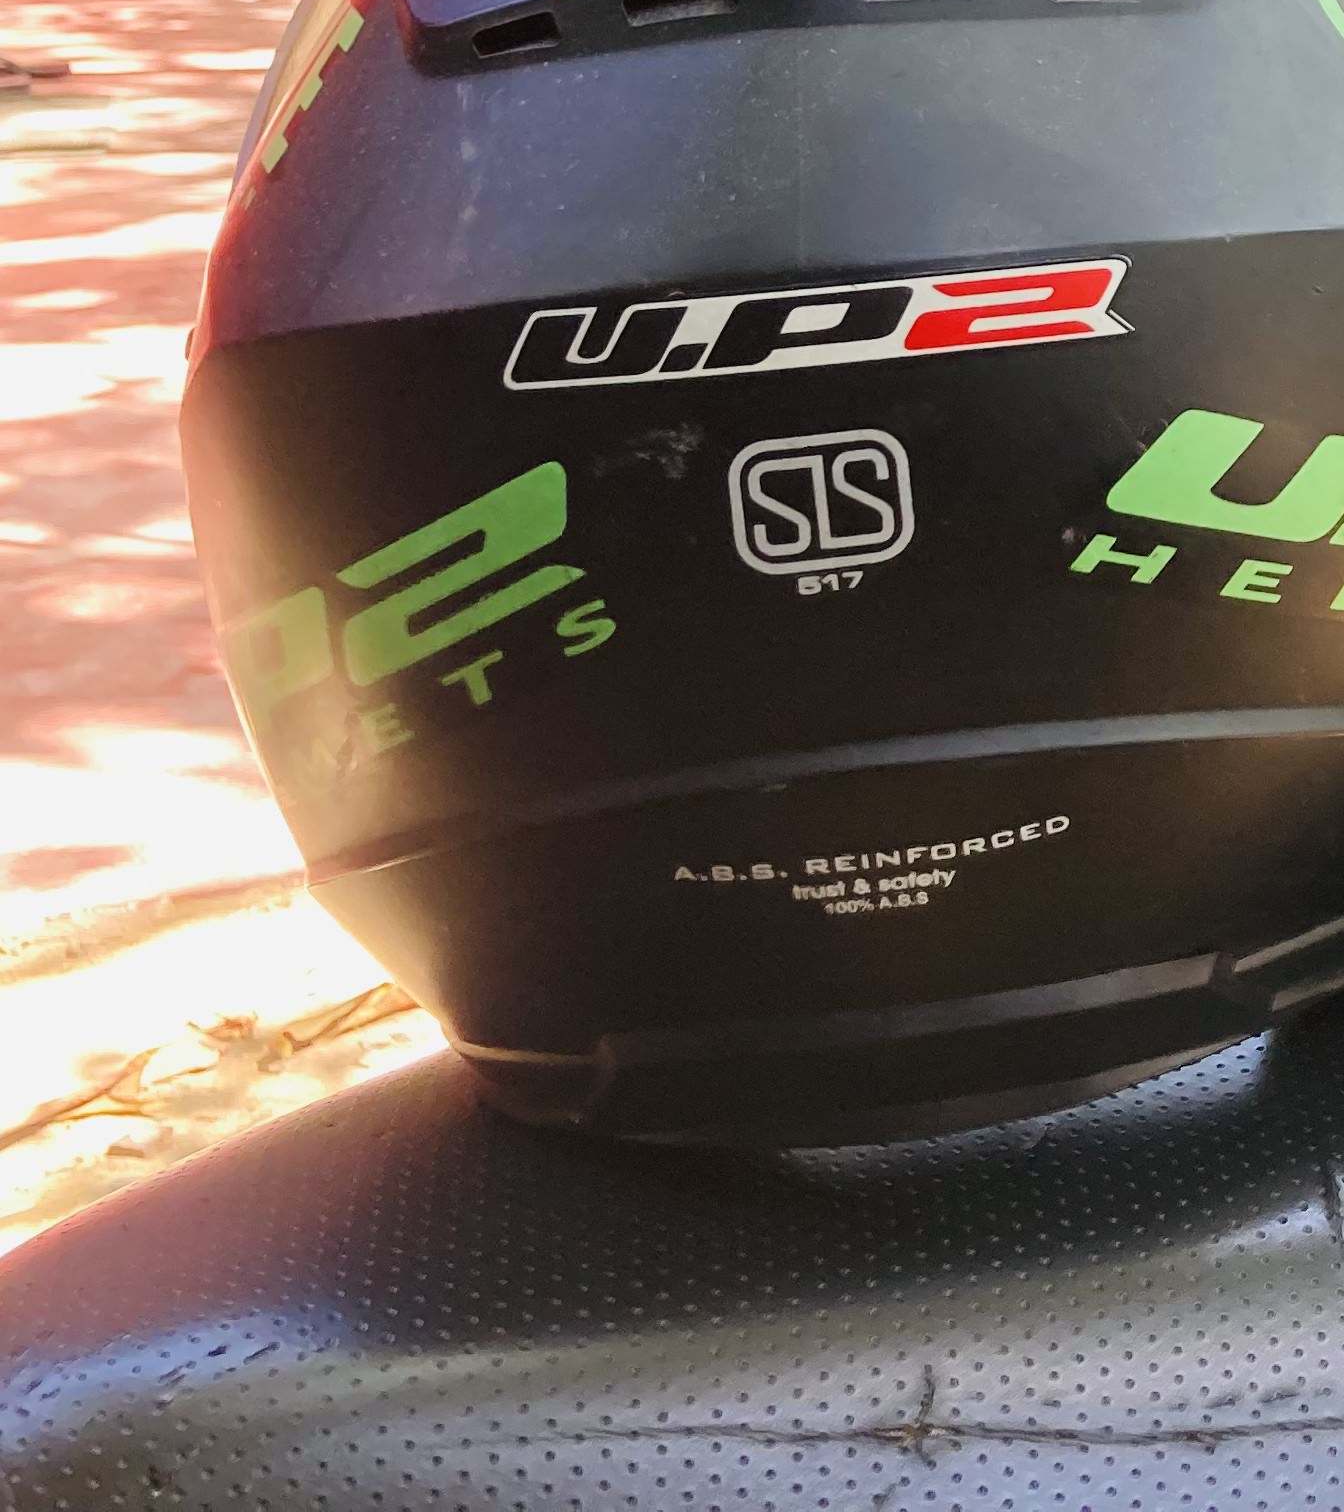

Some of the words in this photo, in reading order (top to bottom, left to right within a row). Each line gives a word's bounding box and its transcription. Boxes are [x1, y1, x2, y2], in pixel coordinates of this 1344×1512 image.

[797, 570, 864, 596] 517
[674, 863, 789, 882] A.B.S.
[805, 814, 1072, 874] REINFORCED
[792, 880, 846, 901] trust
[852, 877, 872, 896] &
[878, 867, 957, 892] safety
[824, 898, 875, 915] 100%
